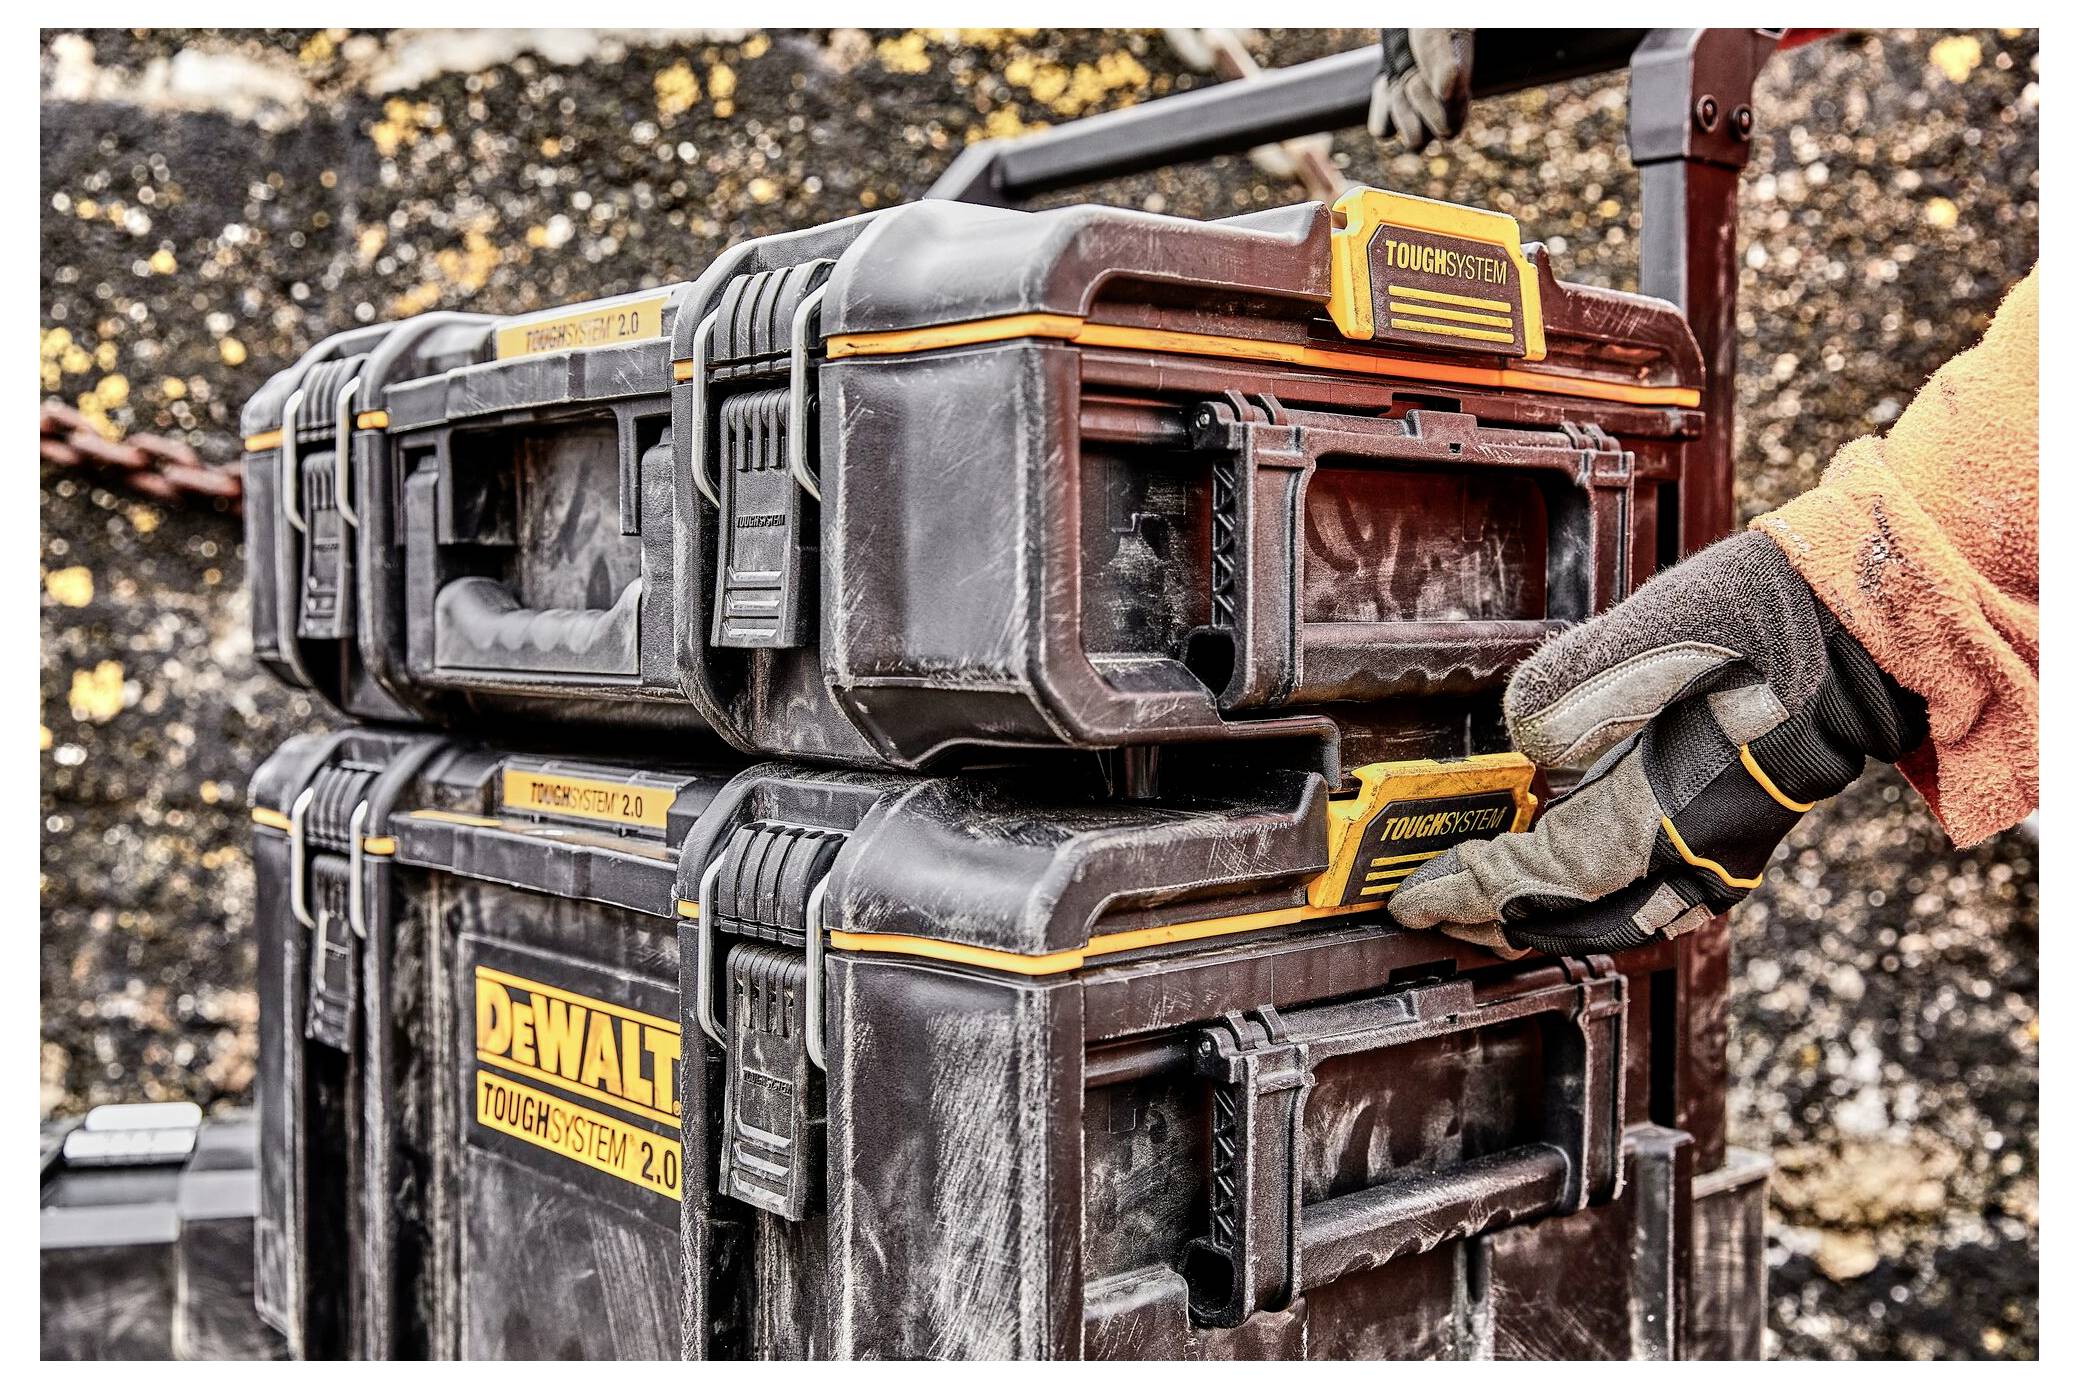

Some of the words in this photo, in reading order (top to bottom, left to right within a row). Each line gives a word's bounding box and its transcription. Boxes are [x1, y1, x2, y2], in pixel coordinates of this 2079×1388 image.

[1385, 239, 1507, 285] TOUGHSYSTEM
[526, 316, 612, 353] TOUGHSYSTEM
[618, 311, 639, 337] 2.0
[530, 782, 616, 815] TOUGHSYSTEM
[622, 794, 643, 818] 2.0
[1380, 805, 1507, 842] TOUGHSYSTEM
[483, 1082, 629, 1170] TOUGHSYSTEM
[641, 1141, 678, 1191] 2.0
